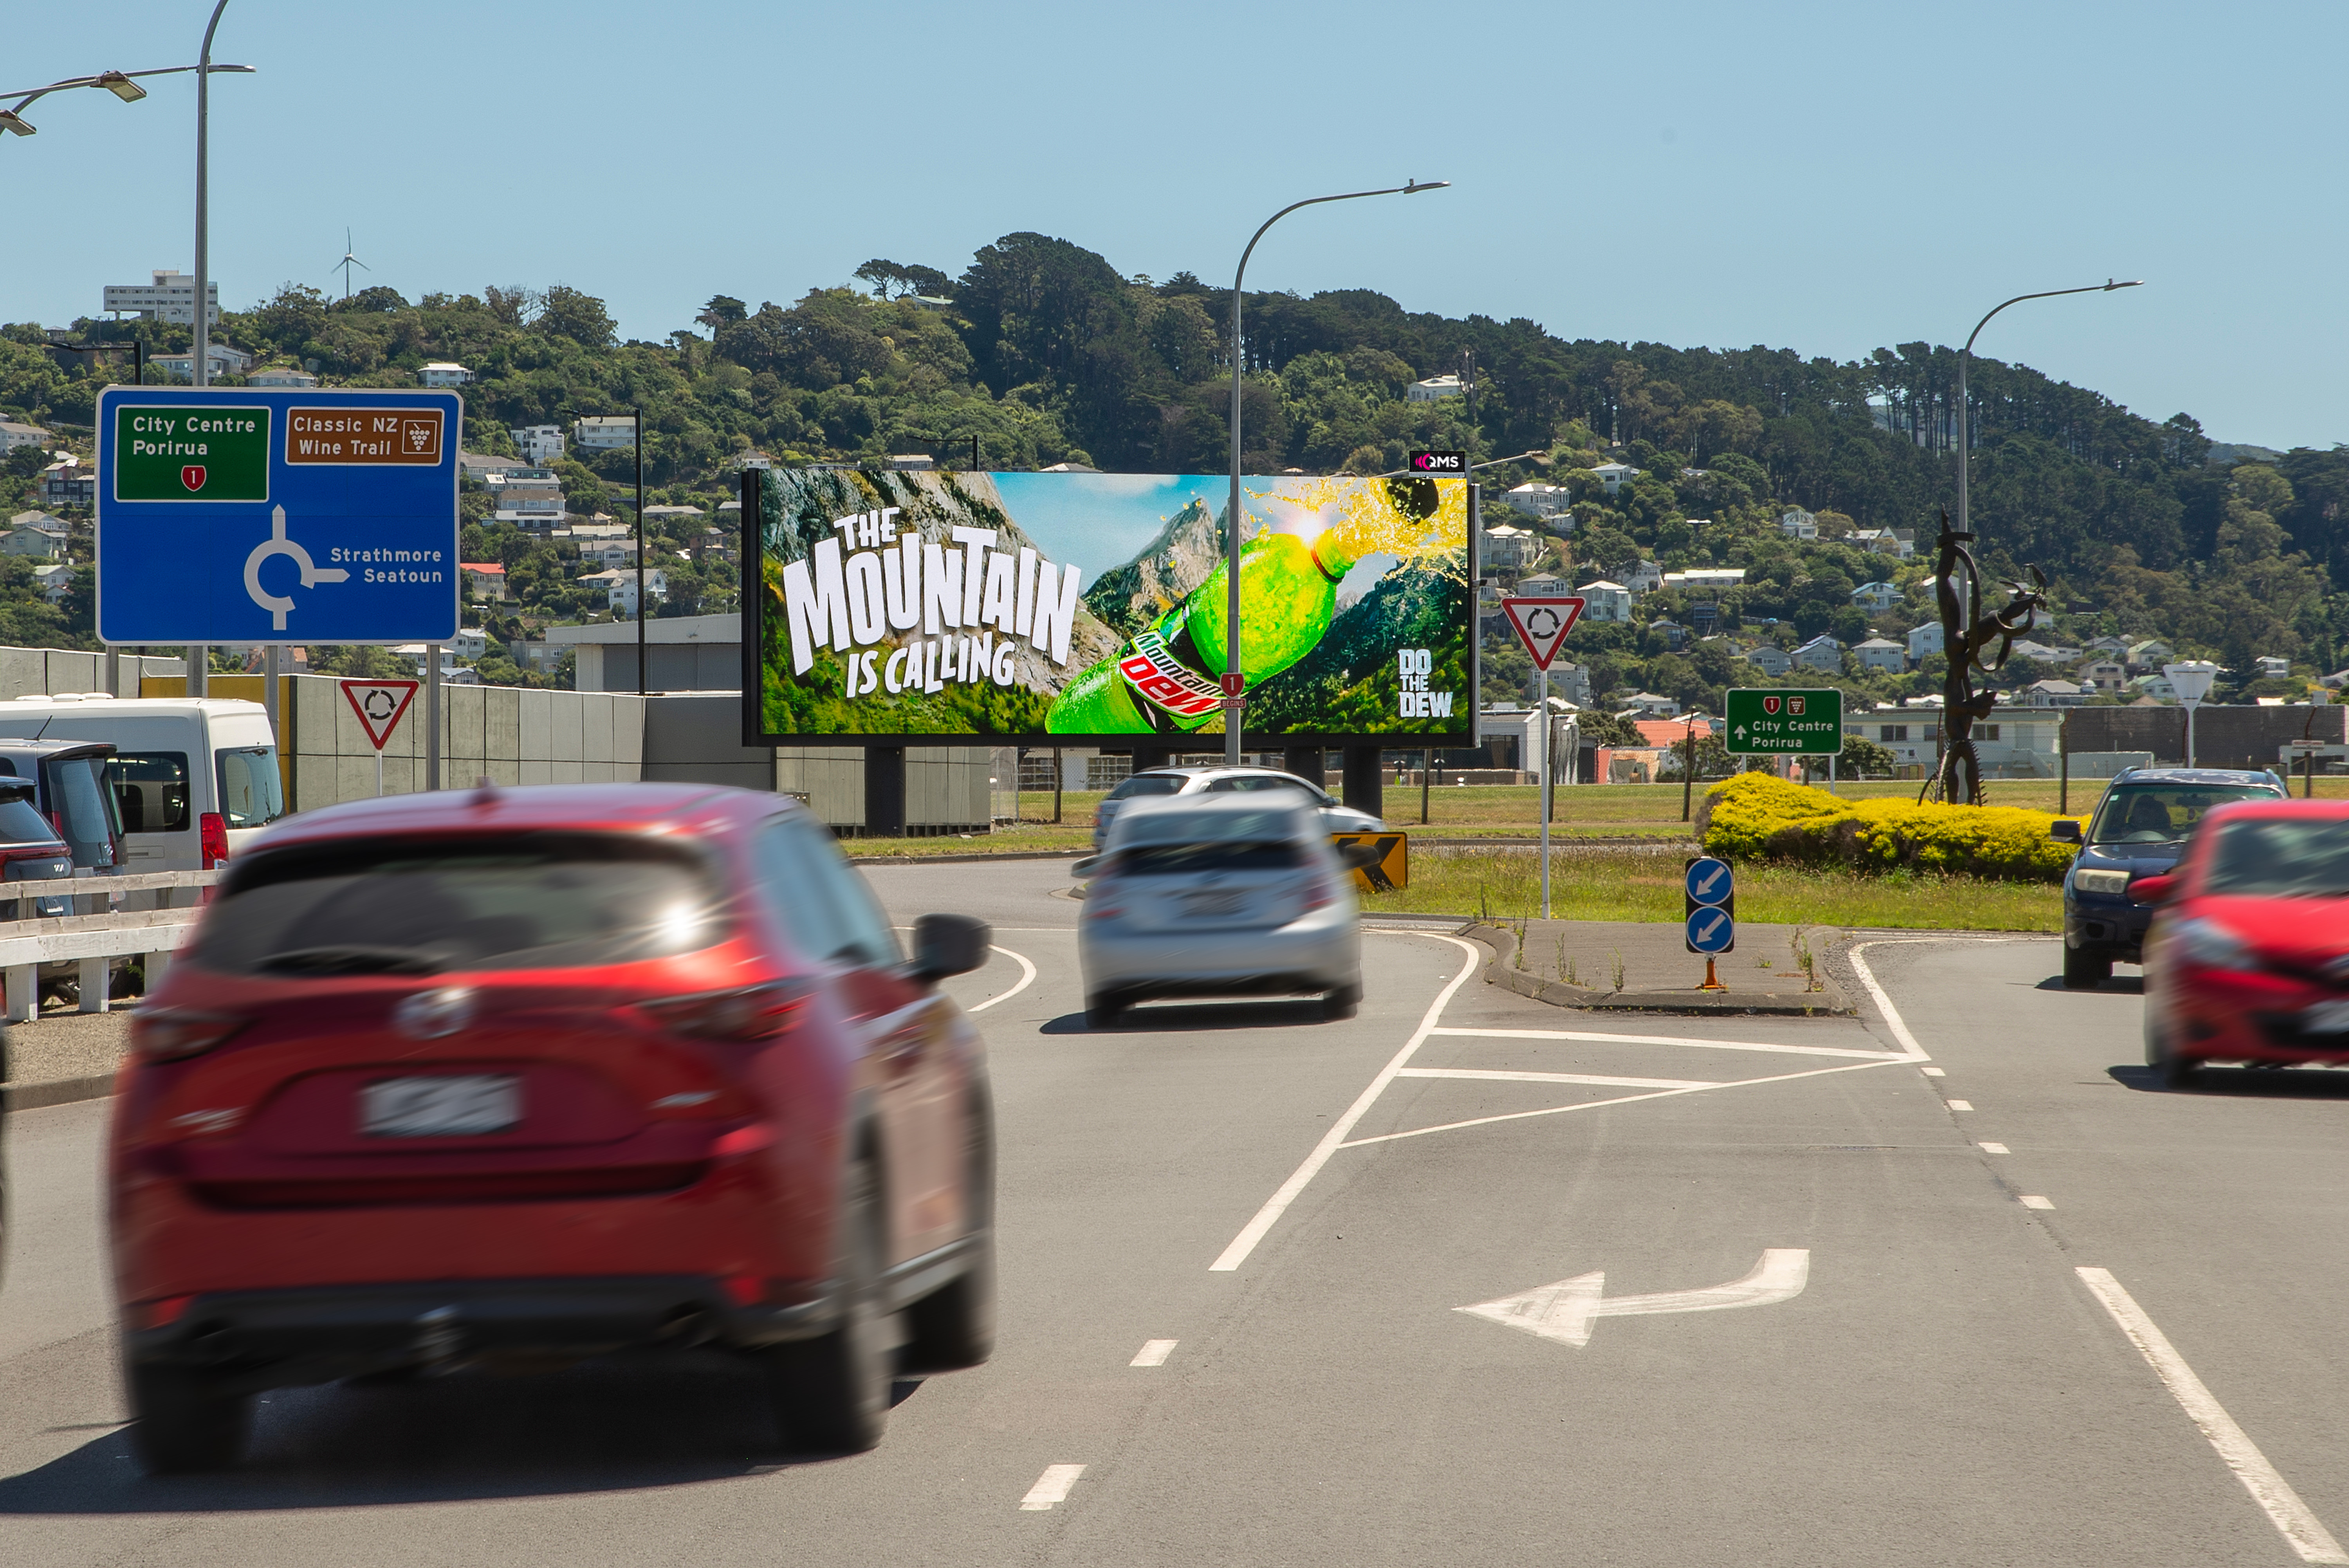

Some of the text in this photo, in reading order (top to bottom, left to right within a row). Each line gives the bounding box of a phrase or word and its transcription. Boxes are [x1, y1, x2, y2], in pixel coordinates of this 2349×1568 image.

[134, 417, 255, 435] City Centre
[294, 417, 398, 433] Classic NZ
[133, 440, 207, 455] Porirua
[299, 439, 391, 455] Wine Trail
[1422, 453, 1459, 470] QMS
[191, 470, 195, 484] 1
[834, 507, 900, 551] THE
[331, 547, 441, 562] Strathmore
[364, 568, 442, 583] Seatoun
[783, 525, 1081, 676] MOUNTAIN
[846, 631, 1015, 698] IS CALLING
[1398, 648, 1432, 675] DO
[1230, 677, 1234, 691] 1
[1399, 675, 1429, 691] THE
[1770, 700, 1774, 710] 1
[1753, 721, 1834, 733] City Centre
[1752, 737, 1802, 747] Porirua
